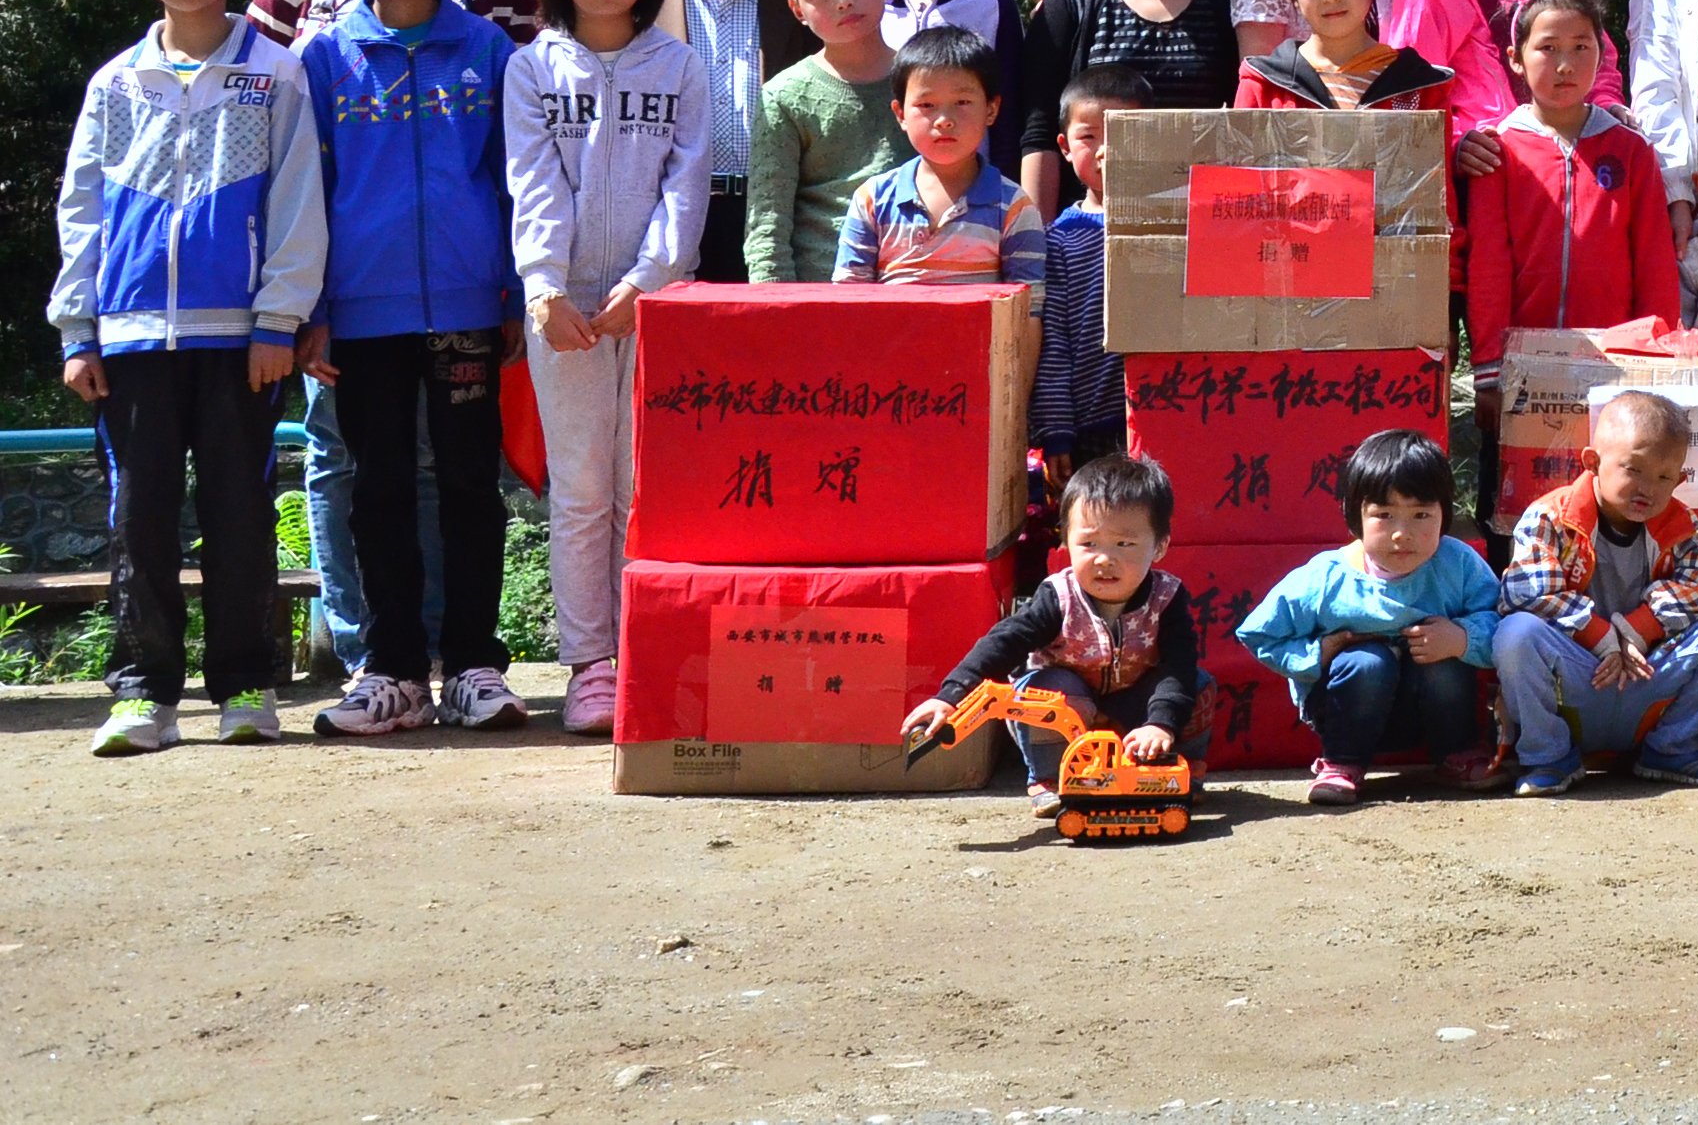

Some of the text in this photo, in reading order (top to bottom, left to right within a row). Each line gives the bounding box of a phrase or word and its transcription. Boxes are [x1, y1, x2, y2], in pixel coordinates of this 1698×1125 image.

[111, 76, 163, 103] Fahion
[726, 629, 886, 645] 西安市城市照明管理处
[674, 744, 741, 757] Box File
